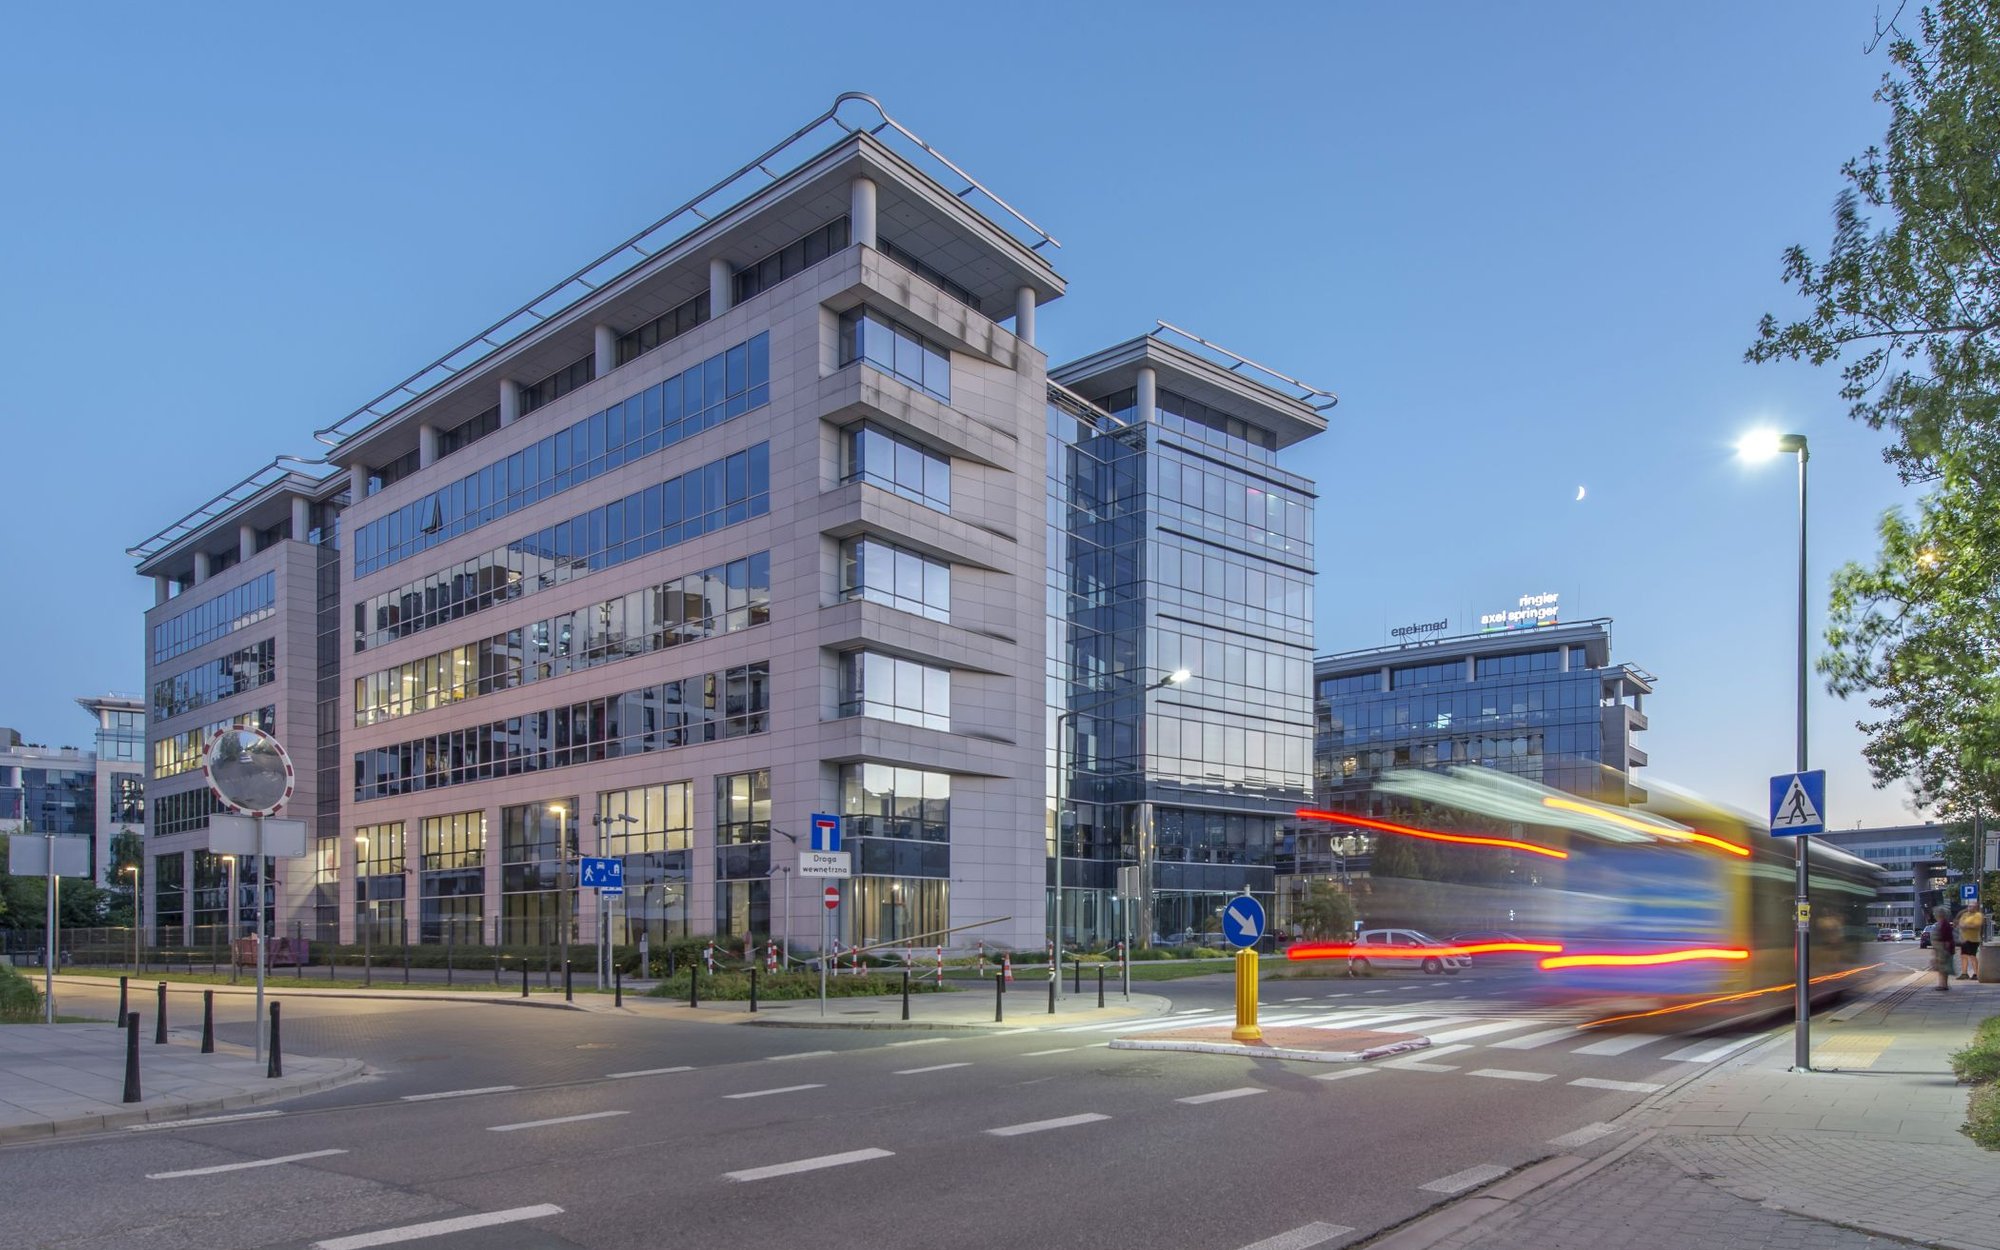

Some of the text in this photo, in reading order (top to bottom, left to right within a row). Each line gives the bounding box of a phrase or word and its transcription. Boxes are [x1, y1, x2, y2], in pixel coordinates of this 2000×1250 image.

[1520, 592, 1559, 606] ringier
[1481, 607, 1559, 624] axel springer
[813, 854, 837, 864] Droga
[802, 866, 847, 874] wewnętrzna
[1964, 886, 1975, 897] P
